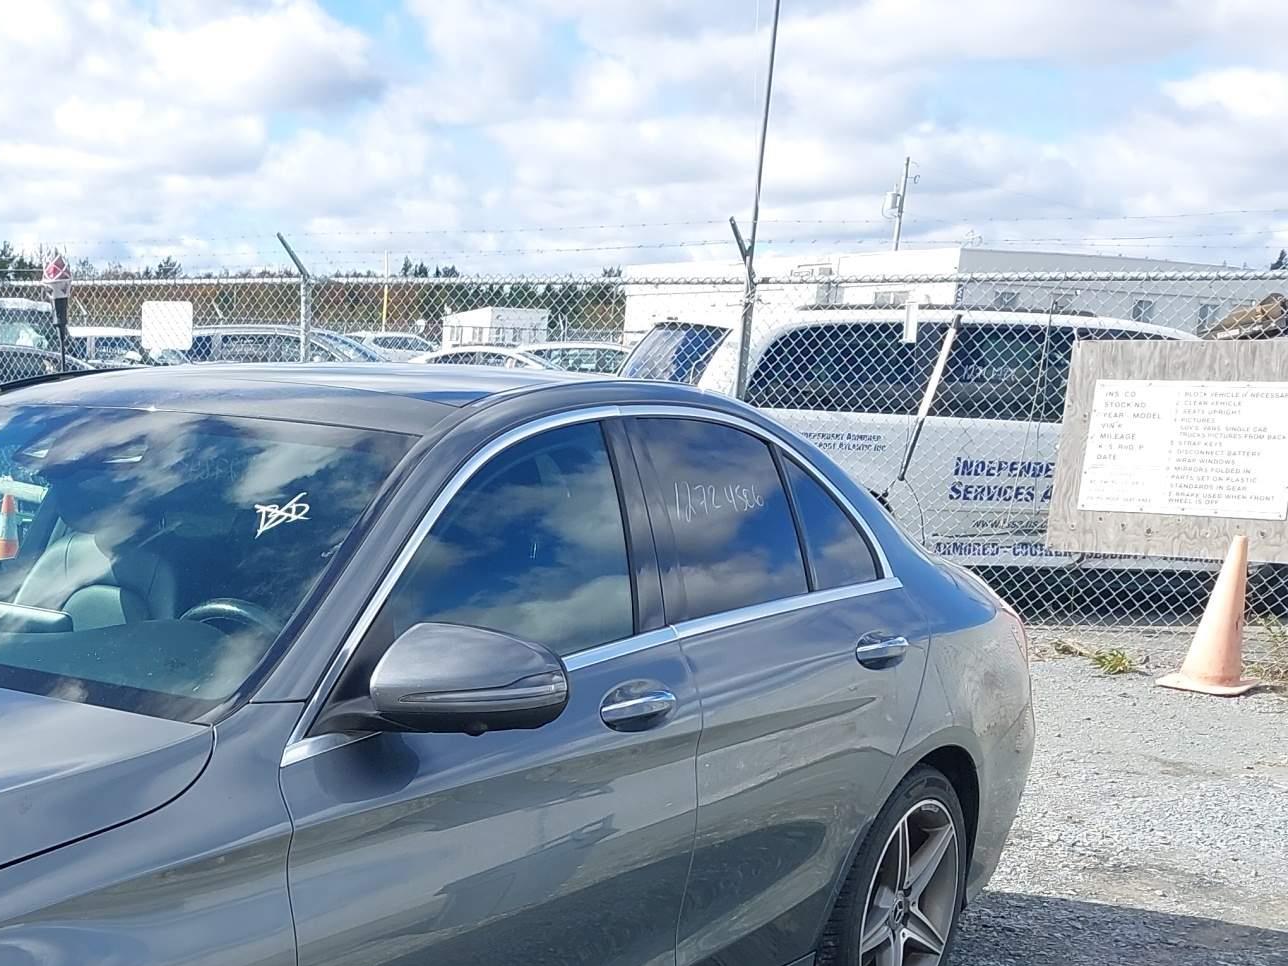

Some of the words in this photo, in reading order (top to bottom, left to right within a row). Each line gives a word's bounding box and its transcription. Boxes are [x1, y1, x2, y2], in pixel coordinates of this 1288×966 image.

[1104, 401, 1131, 409] STOCK
[1133, 412, 1161, 420] MODEL
[1199, 458, 1236, 466] WINDOWS
[949, 481, 1035, 502] SERVICES
